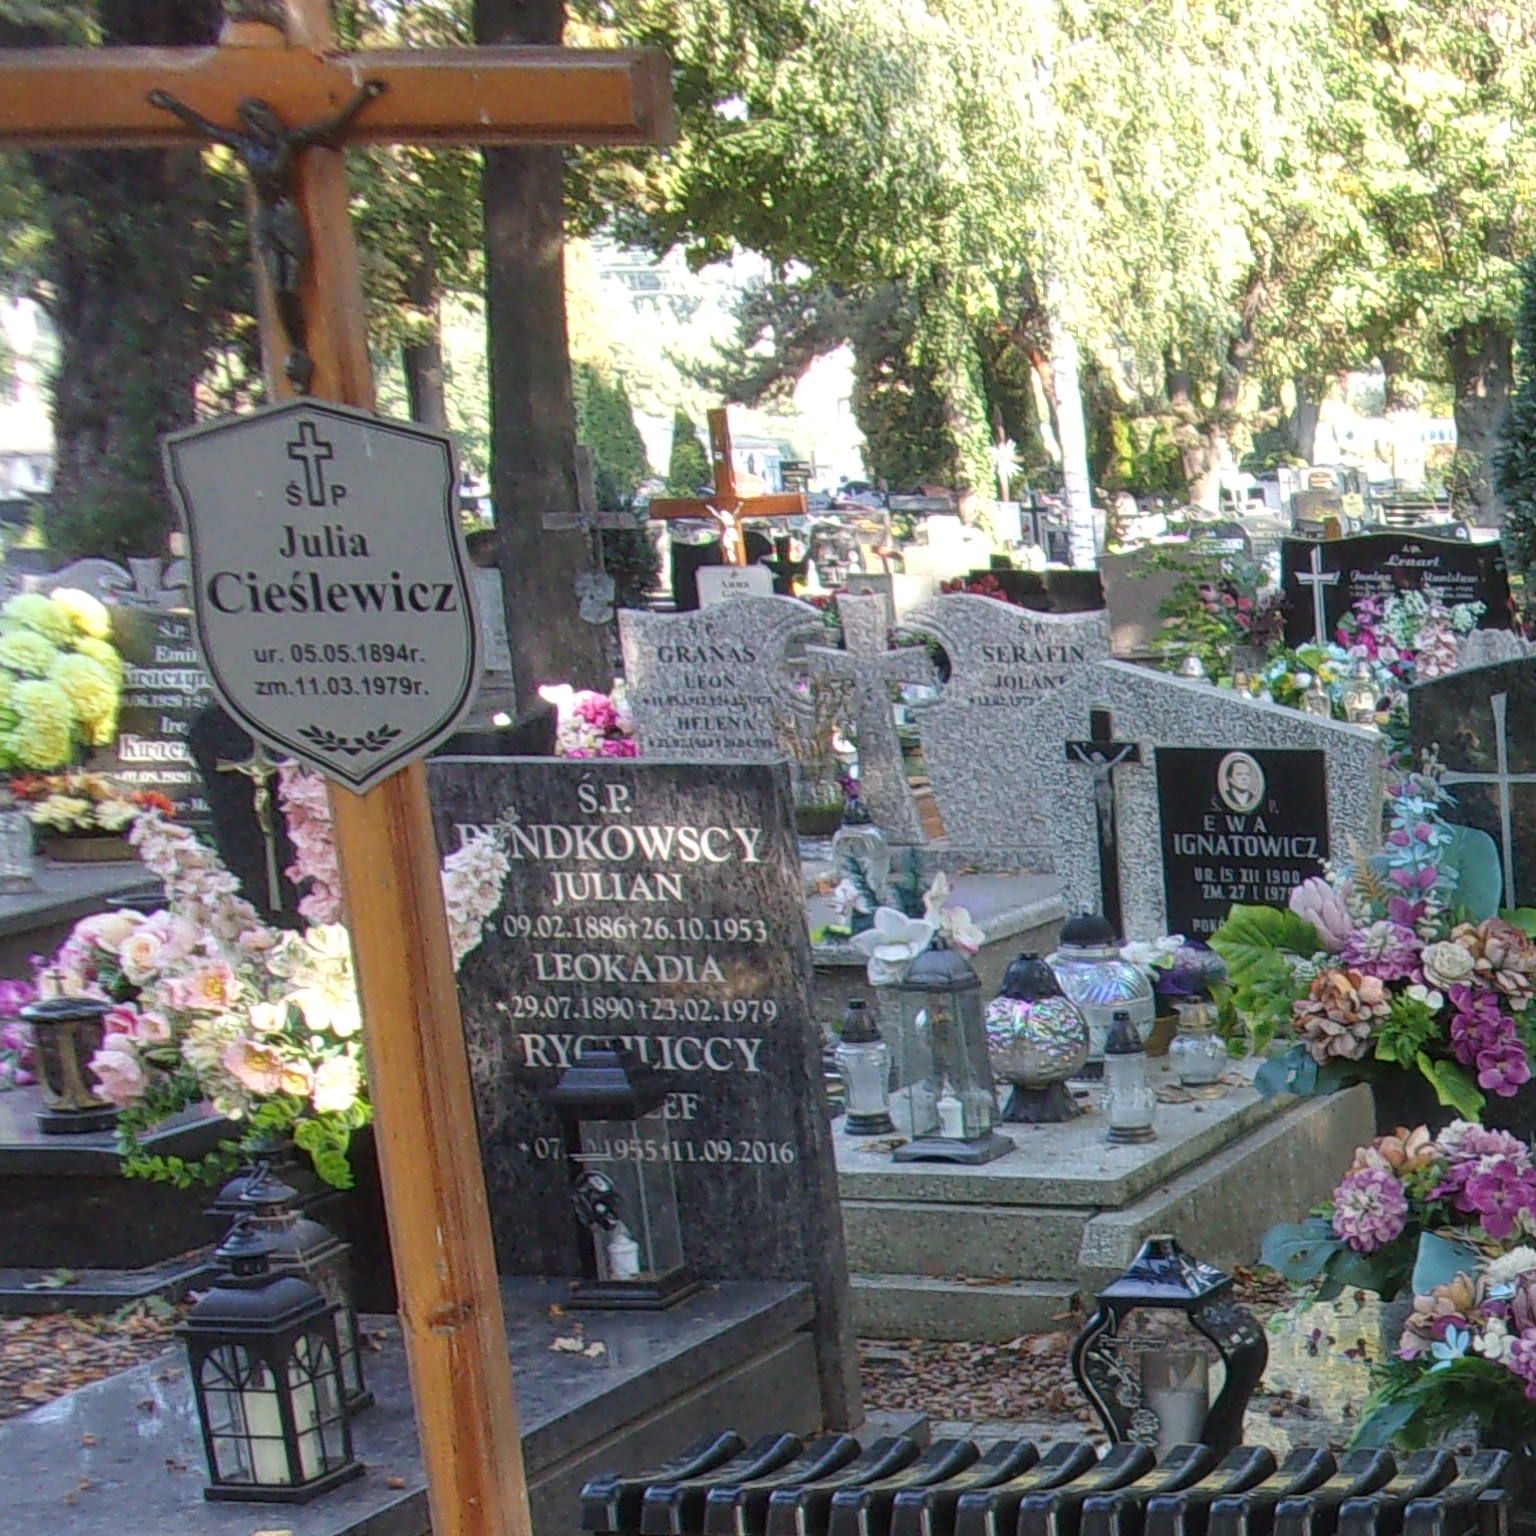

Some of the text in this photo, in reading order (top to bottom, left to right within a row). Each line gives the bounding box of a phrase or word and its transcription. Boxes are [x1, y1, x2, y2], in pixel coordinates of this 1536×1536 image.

[279, 524, 369, 558] Julia
[207, 570, 458, 614] Cieślewicz
[254, 644, 427, 664] ur. 05.05.1894r.
[982, 645, 1085, 663] SERAFIN
[994, 676, 1070, 690] JOLANT
[577, 772, 632, 814] Ś.P.
[1173, 833, 1321, 859] IGNATOWICZ
[550, 872, 684, 906] JULIAN
[1230, 885, 1245, 900] 27
[1192, 917, 1225, 932] POKÓ
[533, 953, 727, 983] LEOKADIA
